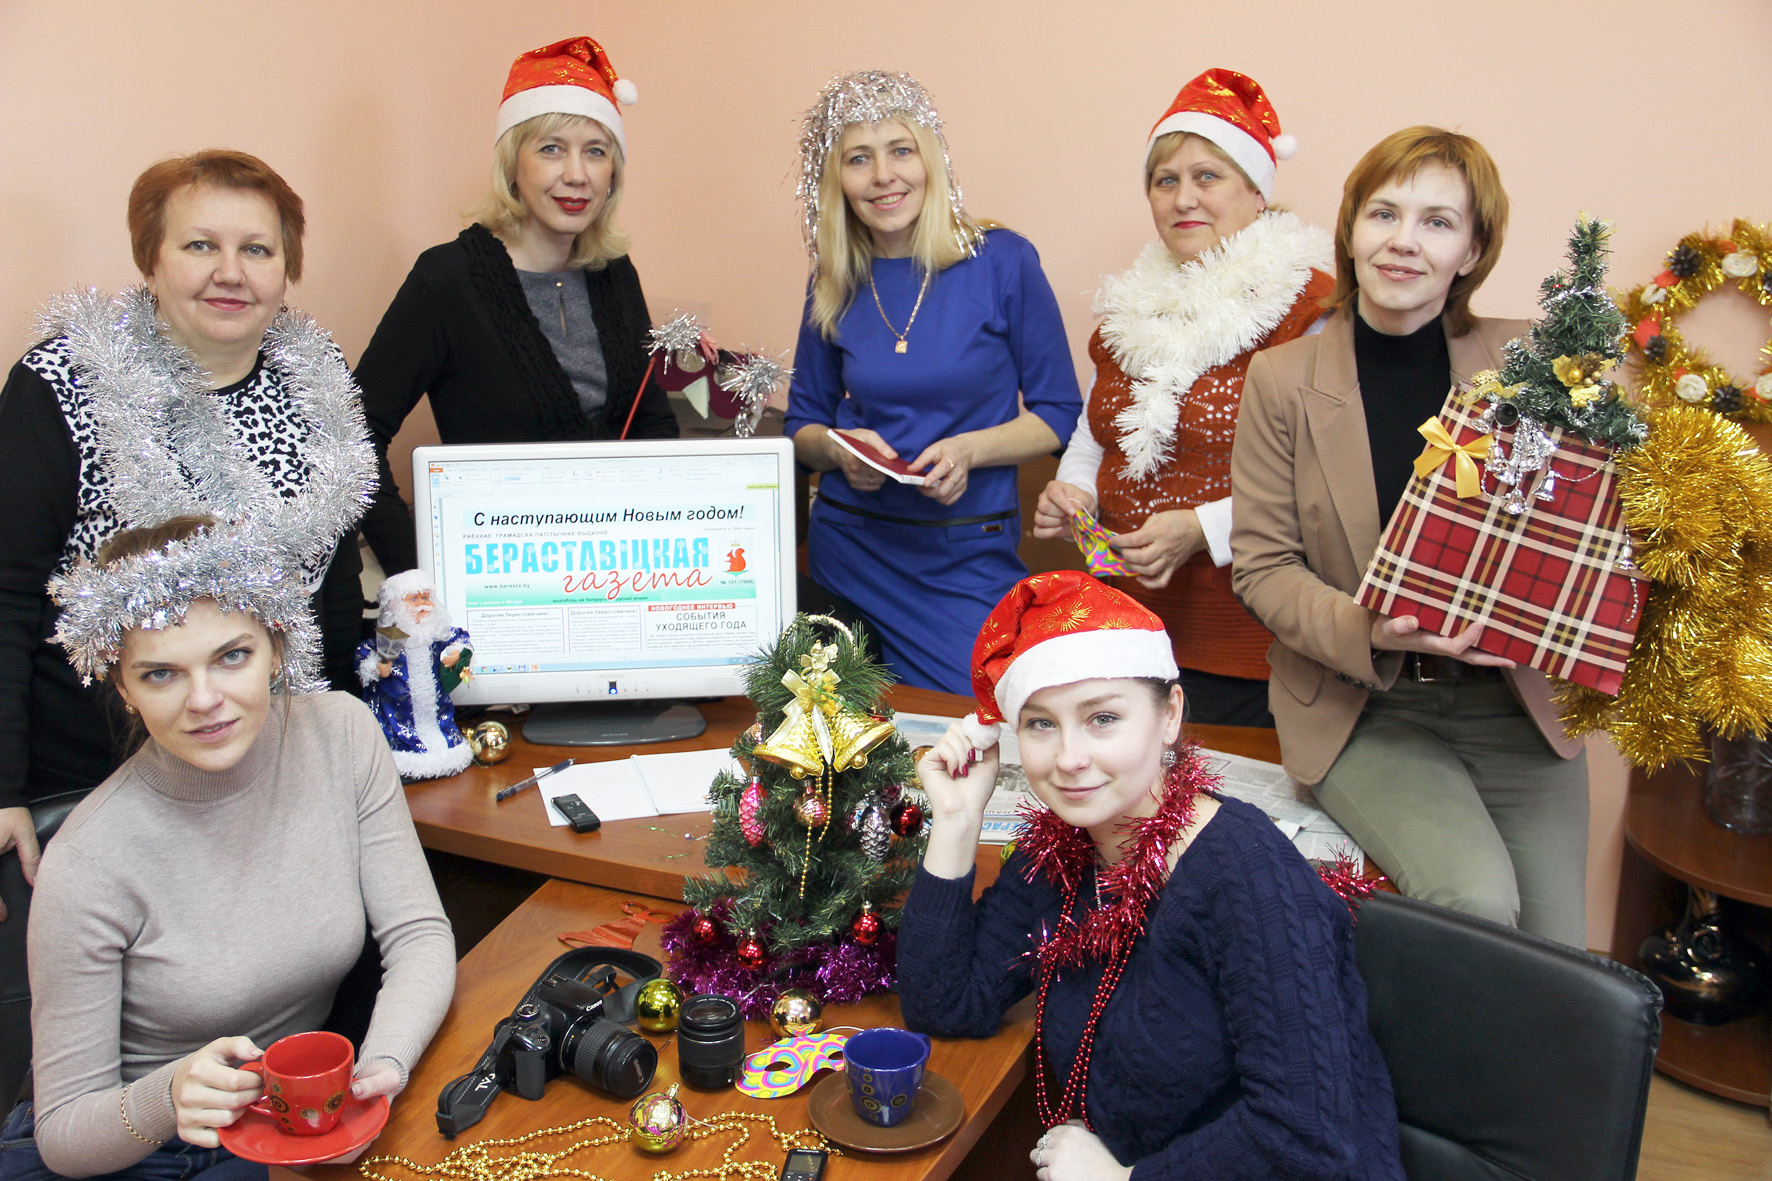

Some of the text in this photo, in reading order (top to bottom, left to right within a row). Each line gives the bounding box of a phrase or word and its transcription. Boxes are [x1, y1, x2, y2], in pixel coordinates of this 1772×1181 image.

[474, 505, 745, 528] С наступающим Новым годом!
[464, 537, 709, 575] БЕРАСТАВІЦКАЯ
[563, 569, 713, 601] газета
[655, 621, 747, 631] УХОДЯЩЕГО ГОДА
[676, 612, 726, 621] СОБЫТИЯ
[585, 999, 603, 1012] Canon
[633, 1058, 644, 1084] Canon
